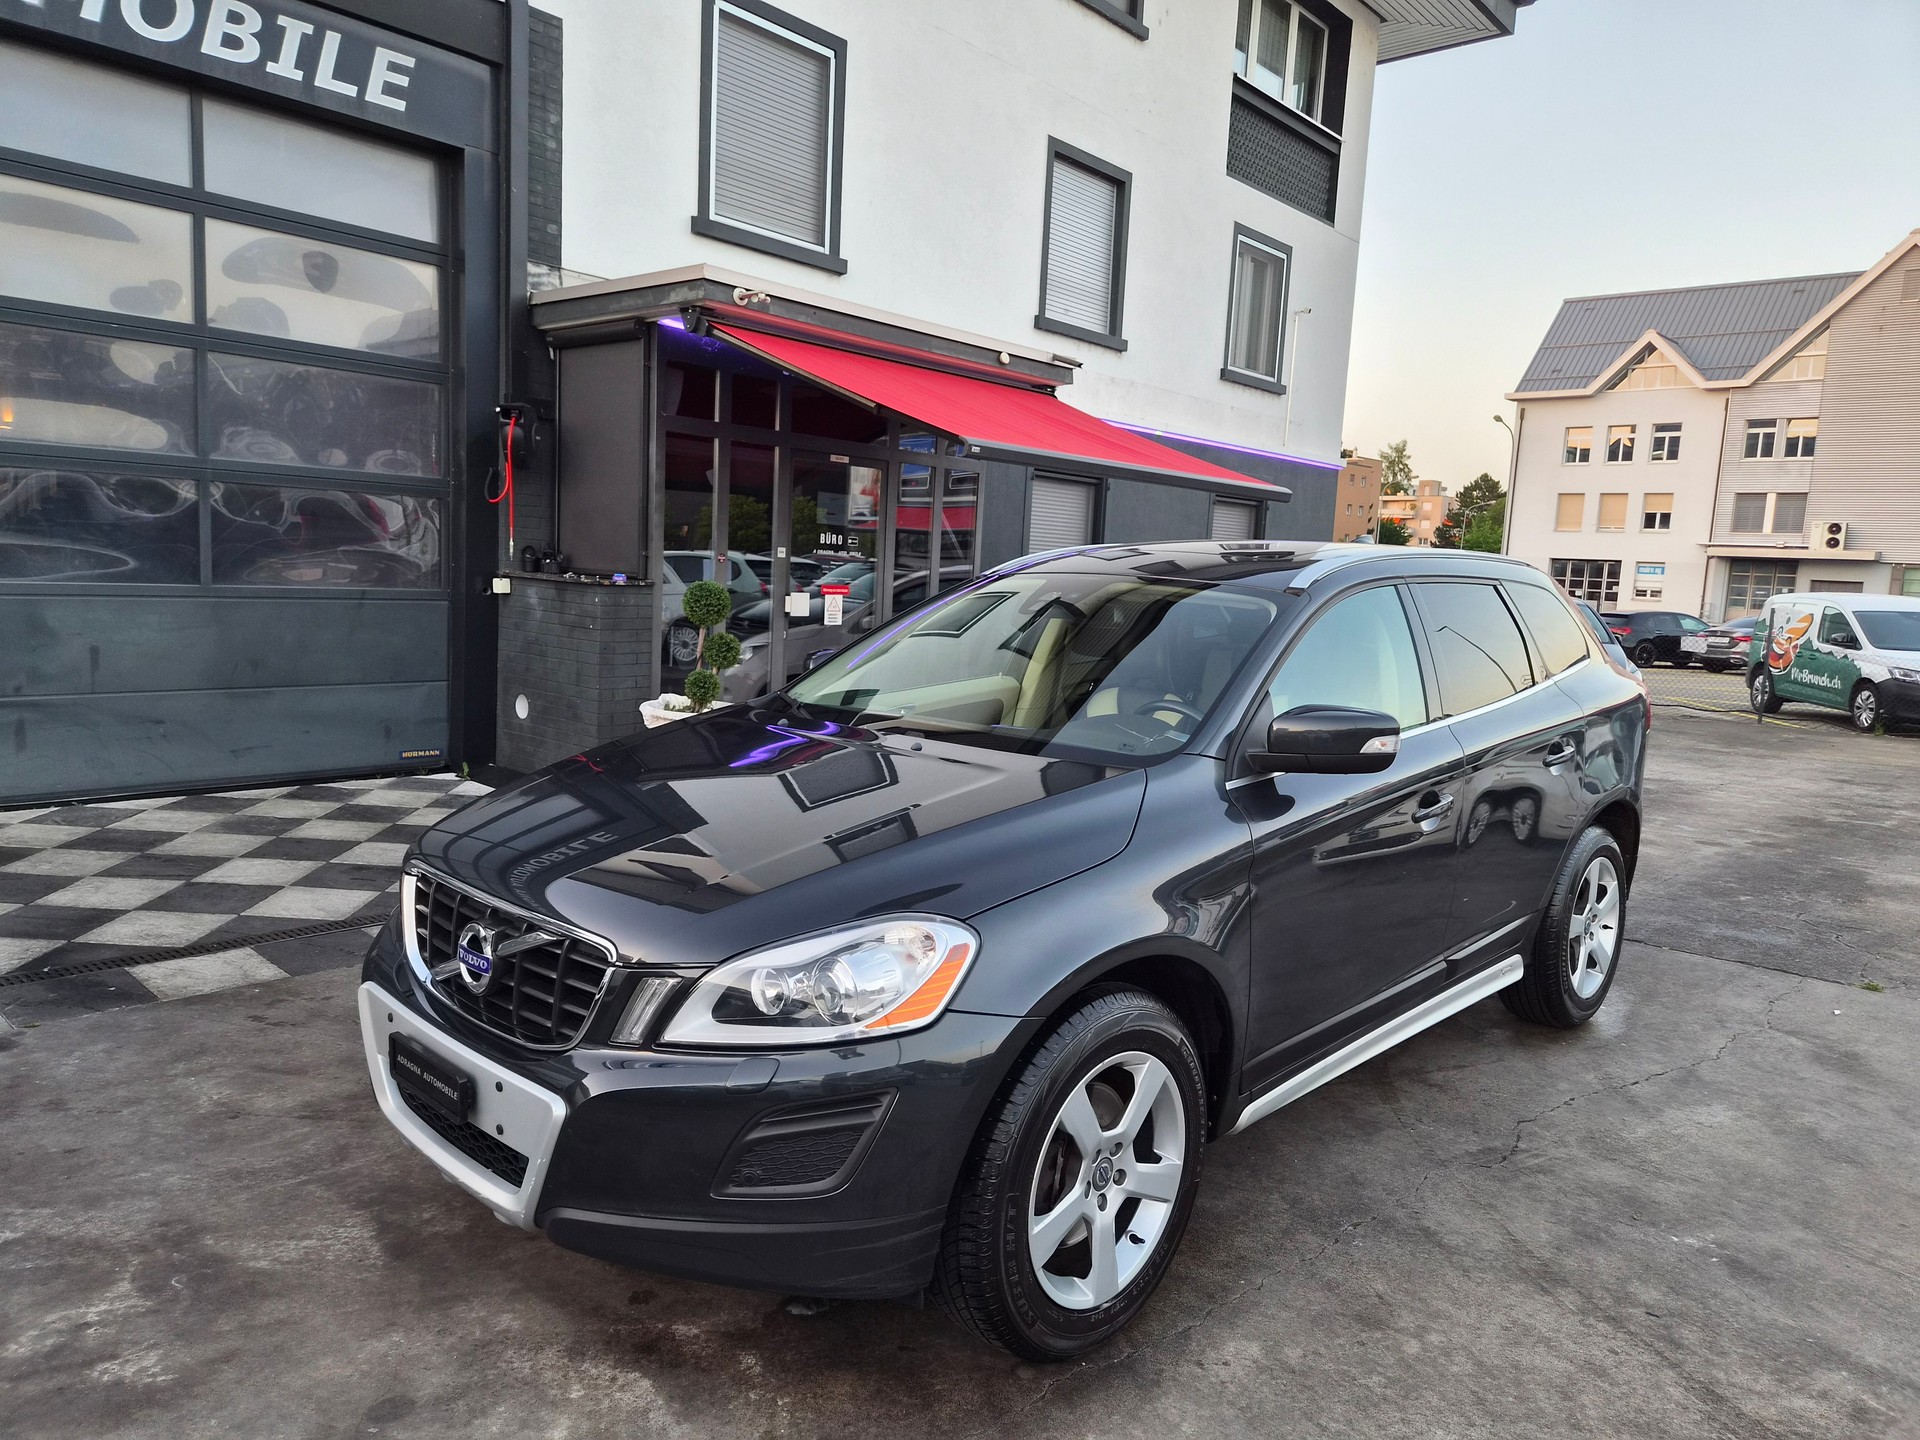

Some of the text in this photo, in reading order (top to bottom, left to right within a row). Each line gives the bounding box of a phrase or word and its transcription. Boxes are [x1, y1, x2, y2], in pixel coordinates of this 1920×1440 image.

[820, 532, 843, 545] BÜRO
[459, 948, 488, 970] VOLVO
[397, 1054, 458, 1101] ADRAGNA AUTOMOBILE
